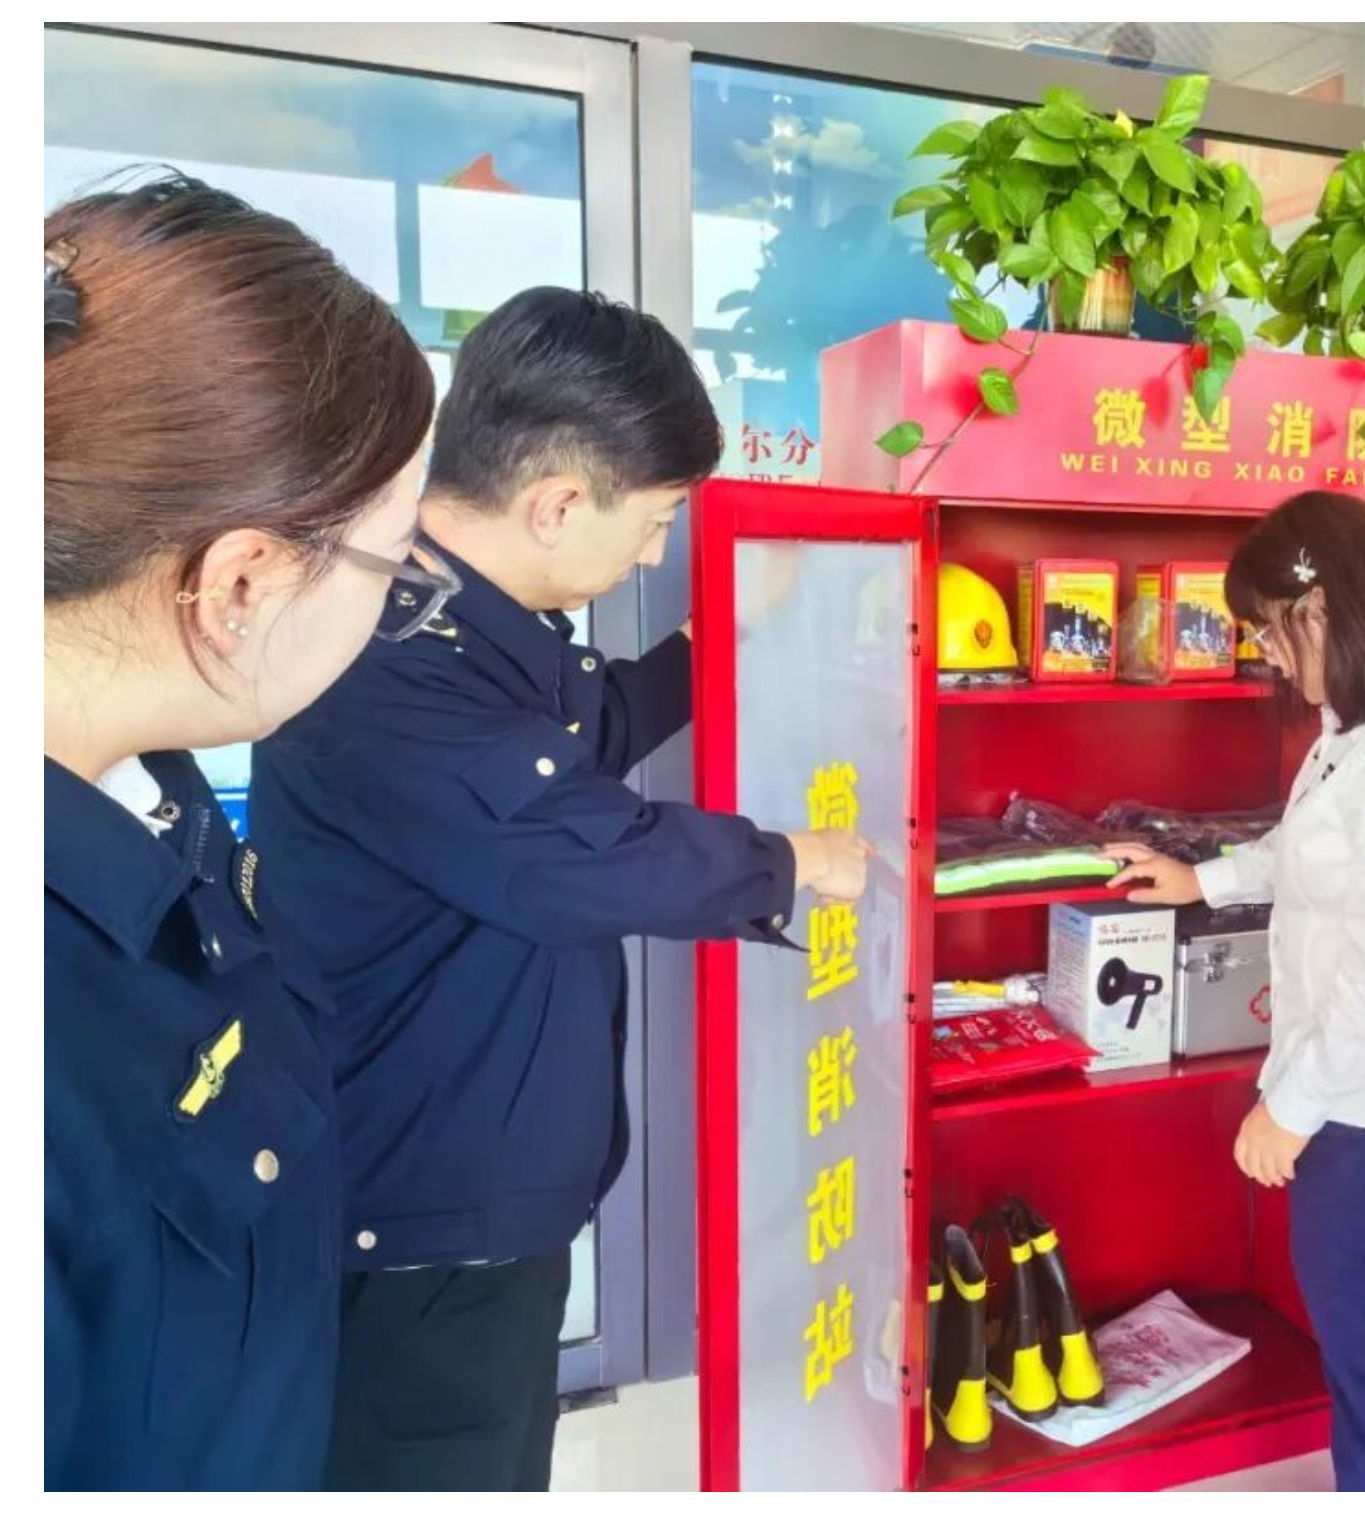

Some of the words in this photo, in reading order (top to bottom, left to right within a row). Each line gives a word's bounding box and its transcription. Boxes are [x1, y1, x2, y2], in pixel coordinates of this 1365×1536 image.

[1060, 452, 1119, 474] WEI
[1136, 456, 1213, 478] XING
[1234, 462, 1306, 484] XIAO
